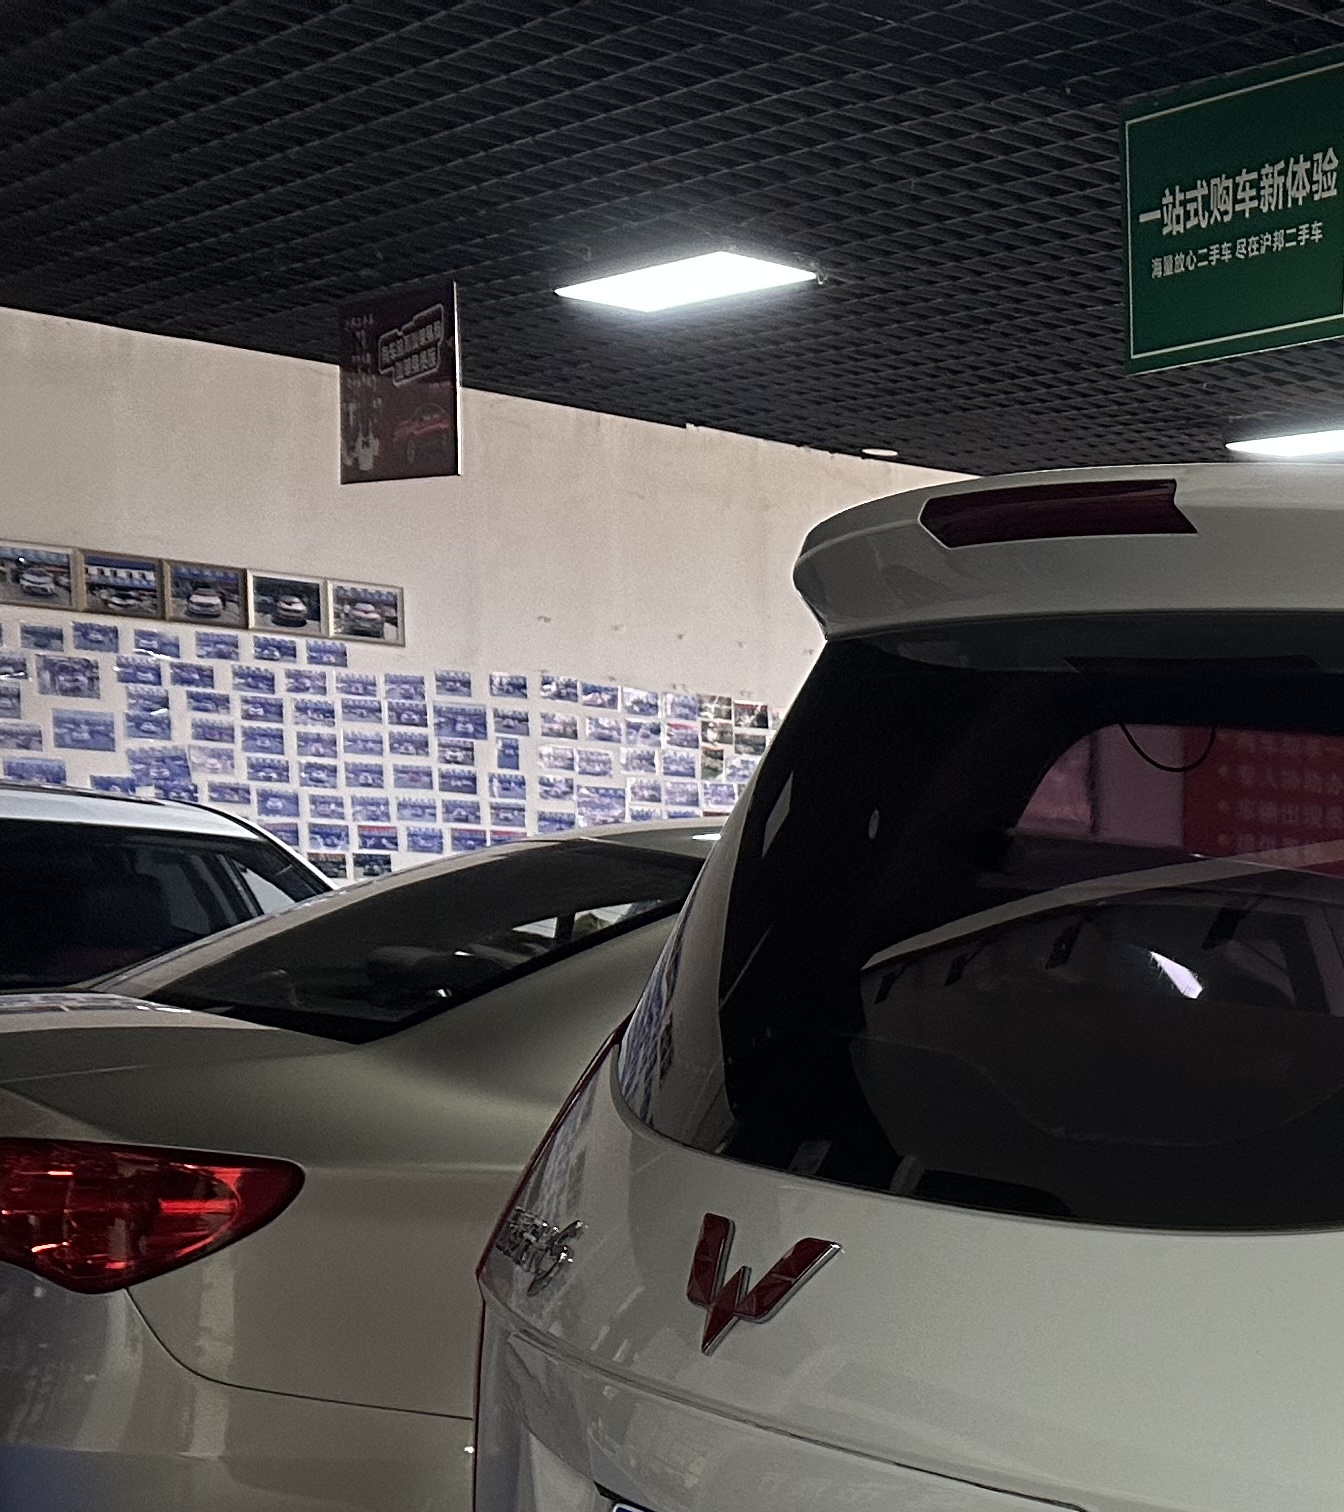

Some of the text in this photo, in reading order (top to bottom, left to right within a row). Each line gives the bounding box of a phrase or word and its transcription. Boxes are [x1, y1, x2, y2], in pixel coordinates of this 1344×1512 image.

[1139, 147, 1339, 235] 一站式购车新体验
[1151, 221, 1324, 278] 海量放心二手车 尽在沪邦二手车
